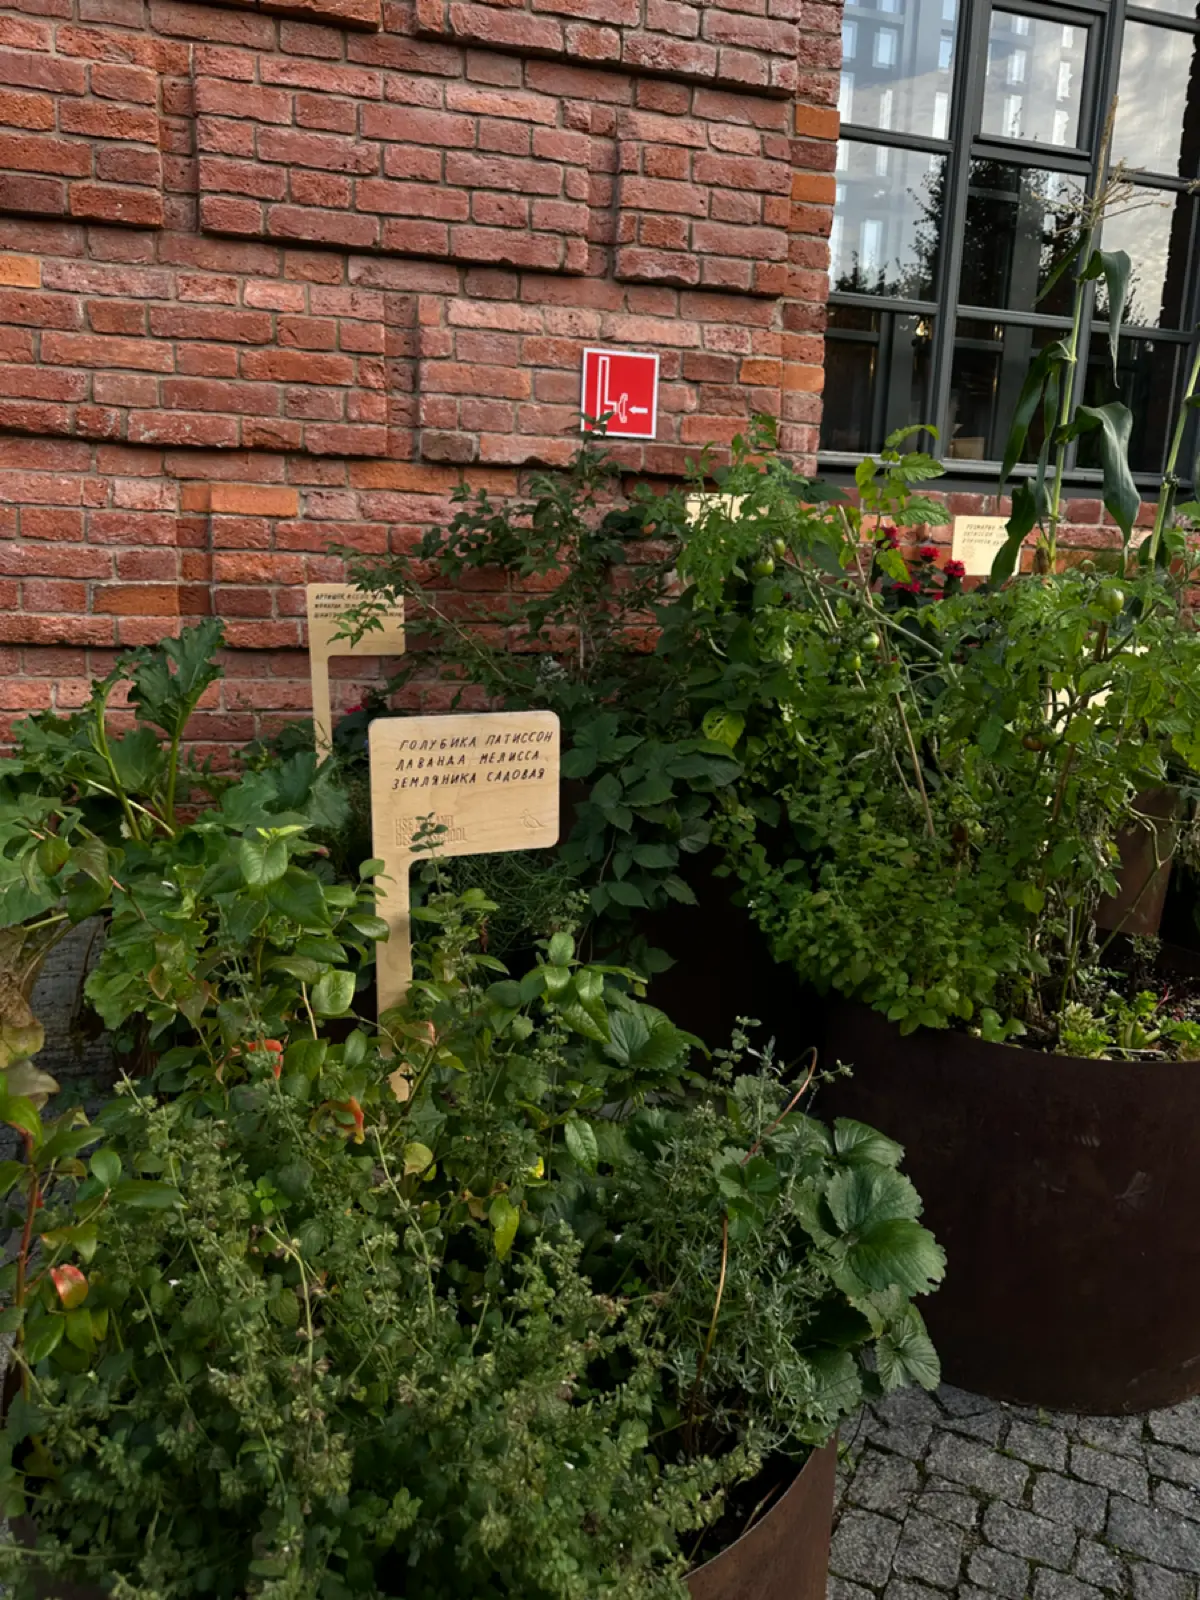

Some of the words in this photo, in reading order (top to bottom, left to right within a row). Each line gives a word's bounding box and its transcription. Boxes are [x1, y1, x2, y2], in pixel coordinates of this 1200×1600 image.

[399, 736, 477, 751] ГОЛУБИКА
[484, 730, 553, 746] ПАТИССОН
[395, 754, 466, 772] ЛАВАНДА
[479, 750, 540, 765] МЕЛИССА
[391, 772, 477, 790] ЗЕМЛЯНИКА
[486, 767, 546, 783] САДОВАЯ
